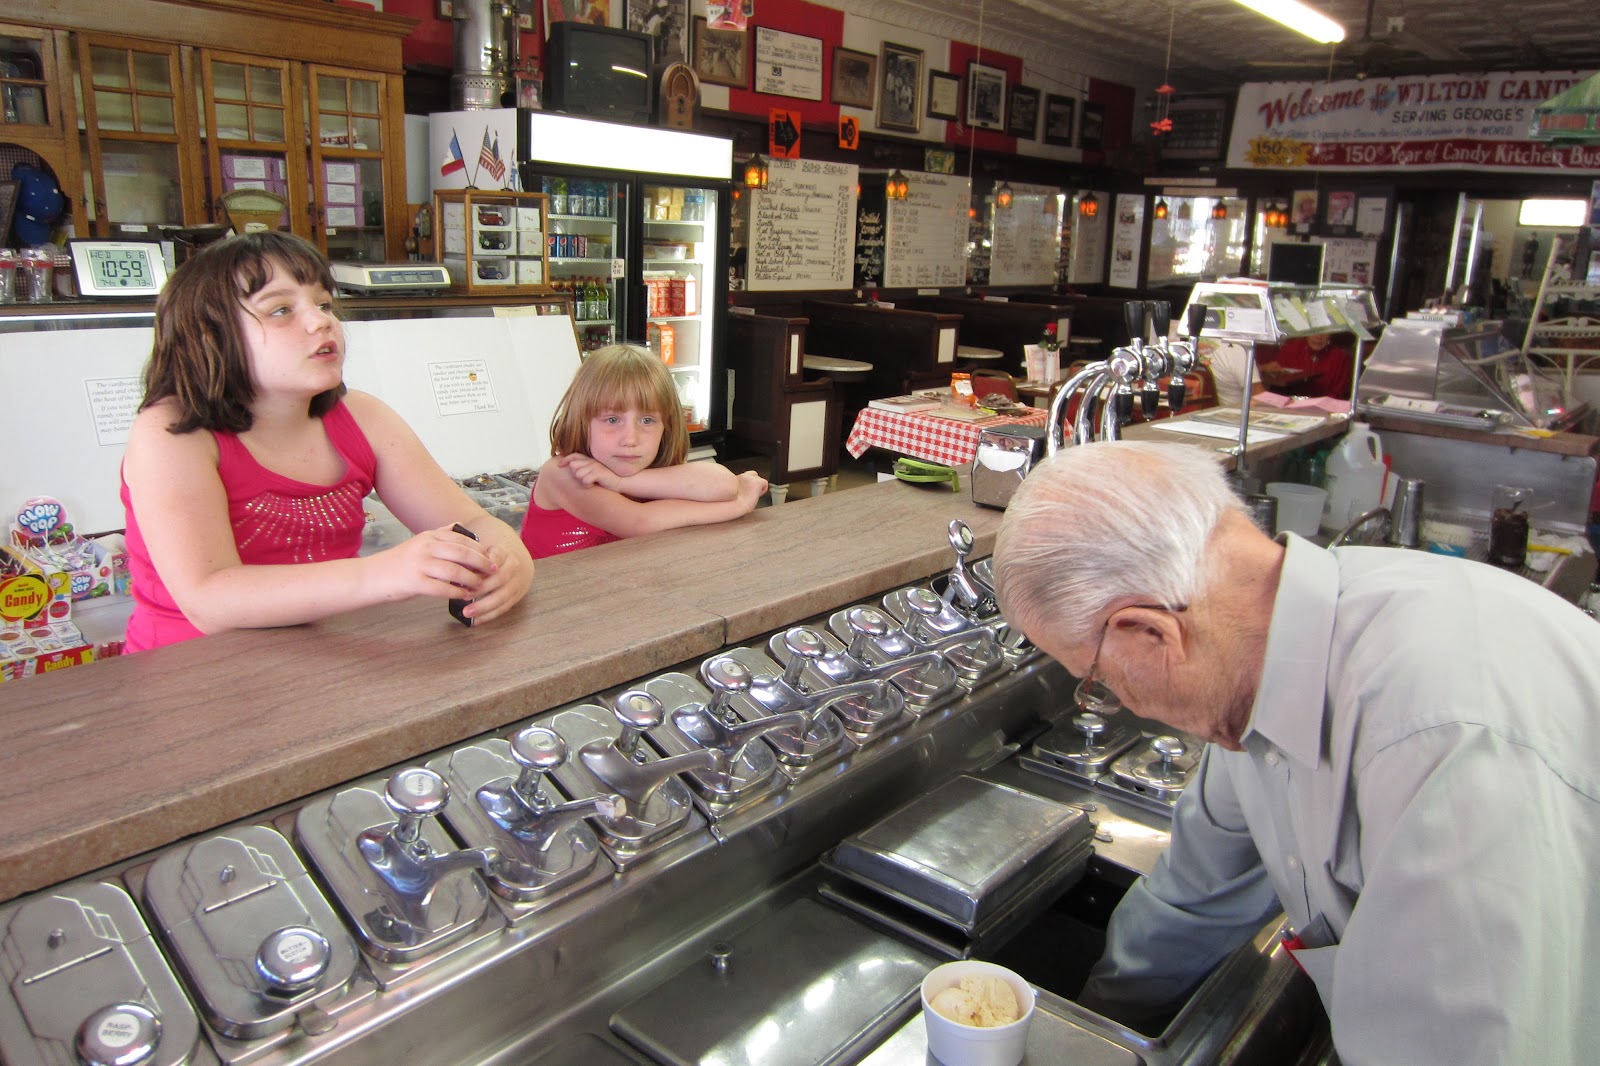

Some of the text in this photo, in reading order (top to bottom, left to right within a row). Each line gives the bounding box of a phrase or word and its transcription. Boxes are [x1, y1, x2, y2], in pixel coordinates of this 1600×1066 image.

[1258, 87, 1365, 129] Welcome
[1397, 79, 1490, 103] WILTON
[1392, 105, 1524, 124] SERVING GEORGE'S
[1257, 142, 1282, 155] 150
[1391, 145, 1422, 164] Year
[1425, 143, 1439, 161] of
[1442, 142, 1491, 164] Candy
[1494, 144, 1563, 164] Kitchen
[90, 251, 145, 259] WED 6 6
[101, 260, 143, 278] 10:59
[18, 503, 60, 527] BLOW
[29, 515, 59, 533] POP
[72, 583, 90, 594] POP
[5, 591, 43, 608] Candy
[45, 655, 75, 672] Candy
[101, 1029, 132, 1038] BERRY
